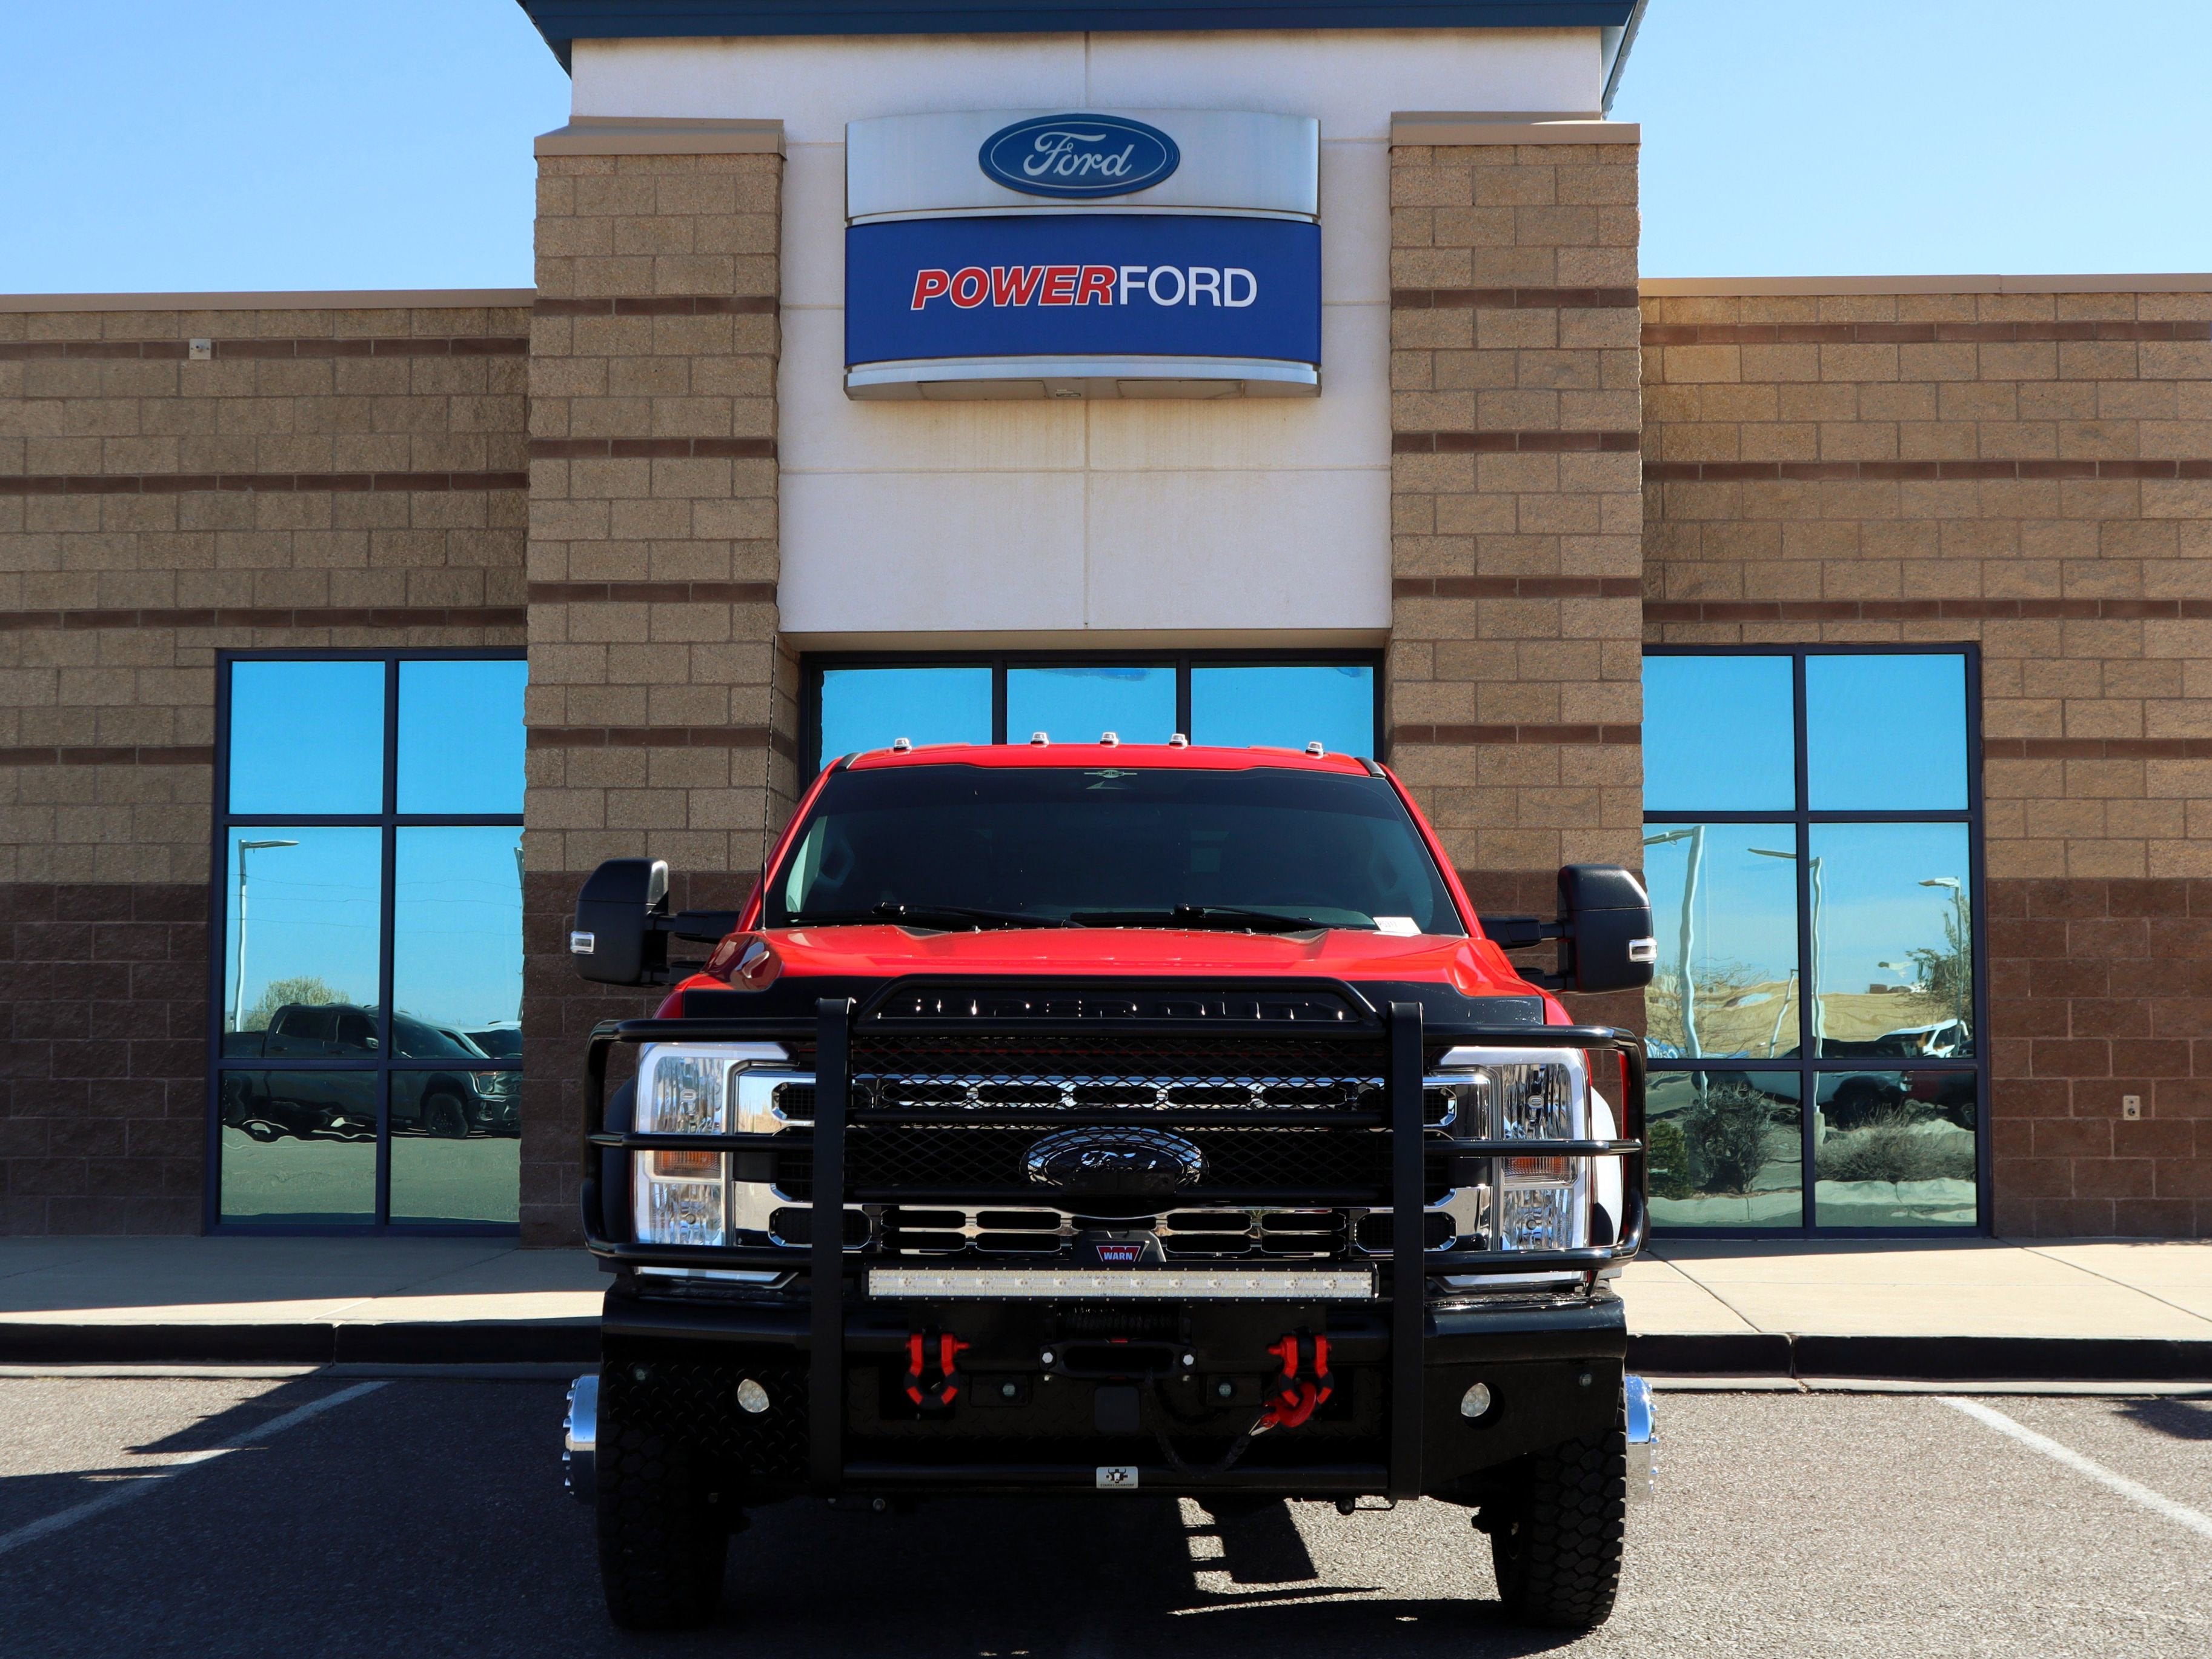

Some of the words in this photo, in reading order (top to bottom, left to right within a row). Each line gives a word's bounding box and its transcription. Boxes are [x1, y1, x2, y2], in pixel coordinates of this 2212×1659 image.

[1023, 131, 1134, 177] Ford
[910, 265, 1257, 311] POWERFORD
[1103, 1252, 1132, 1260] WARN
